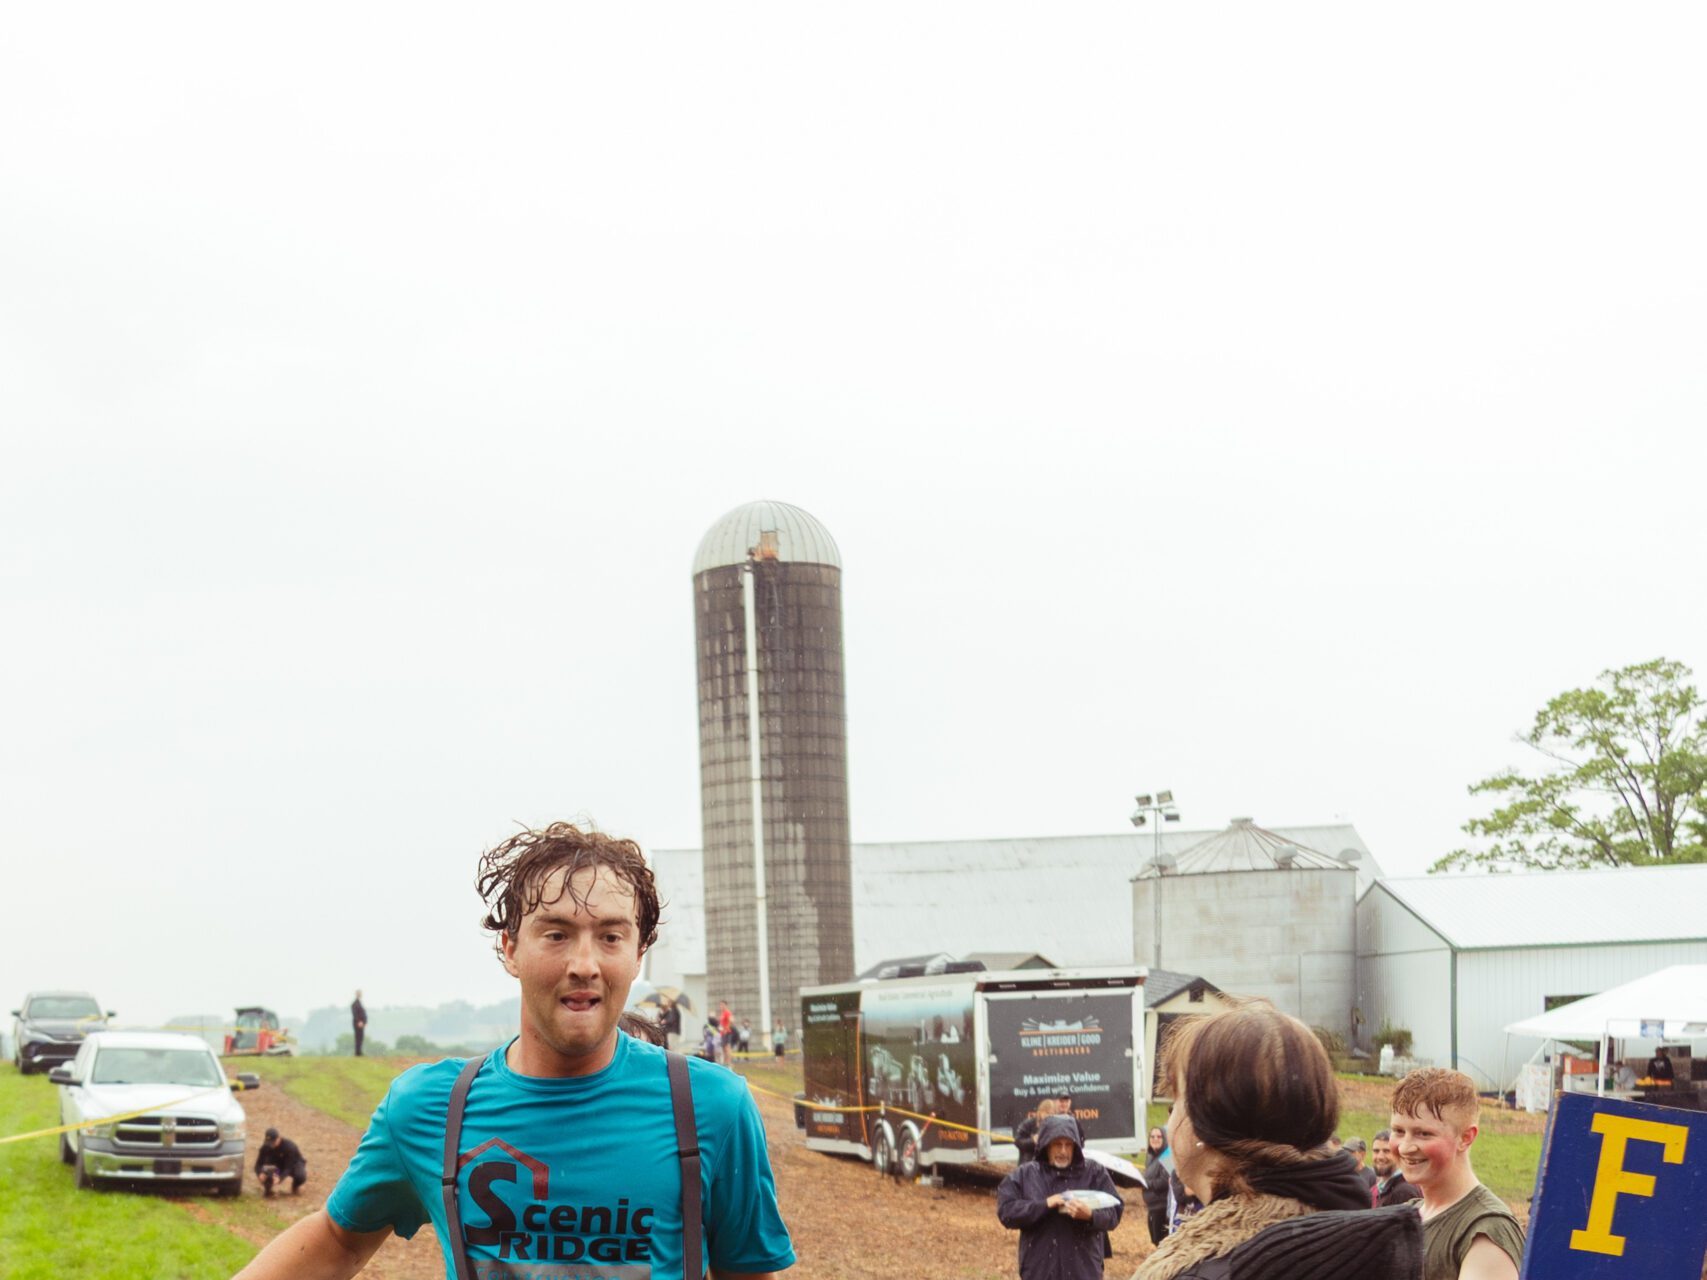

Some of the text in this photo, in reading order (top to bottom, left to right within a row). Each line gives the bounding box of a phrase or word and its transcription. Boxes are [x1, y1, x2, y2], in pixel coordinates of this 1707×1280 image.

[1081, 1034, 1101, 1045] GOOD
[1023, 1072, 1100, 1085] Maximize Value
[1014, 1083, 1110, 1097] Buy & Sell with Confidence
[463, 1161, 654, 1246] Scenic
[499, 1231, 652, 1261] RIDGE
